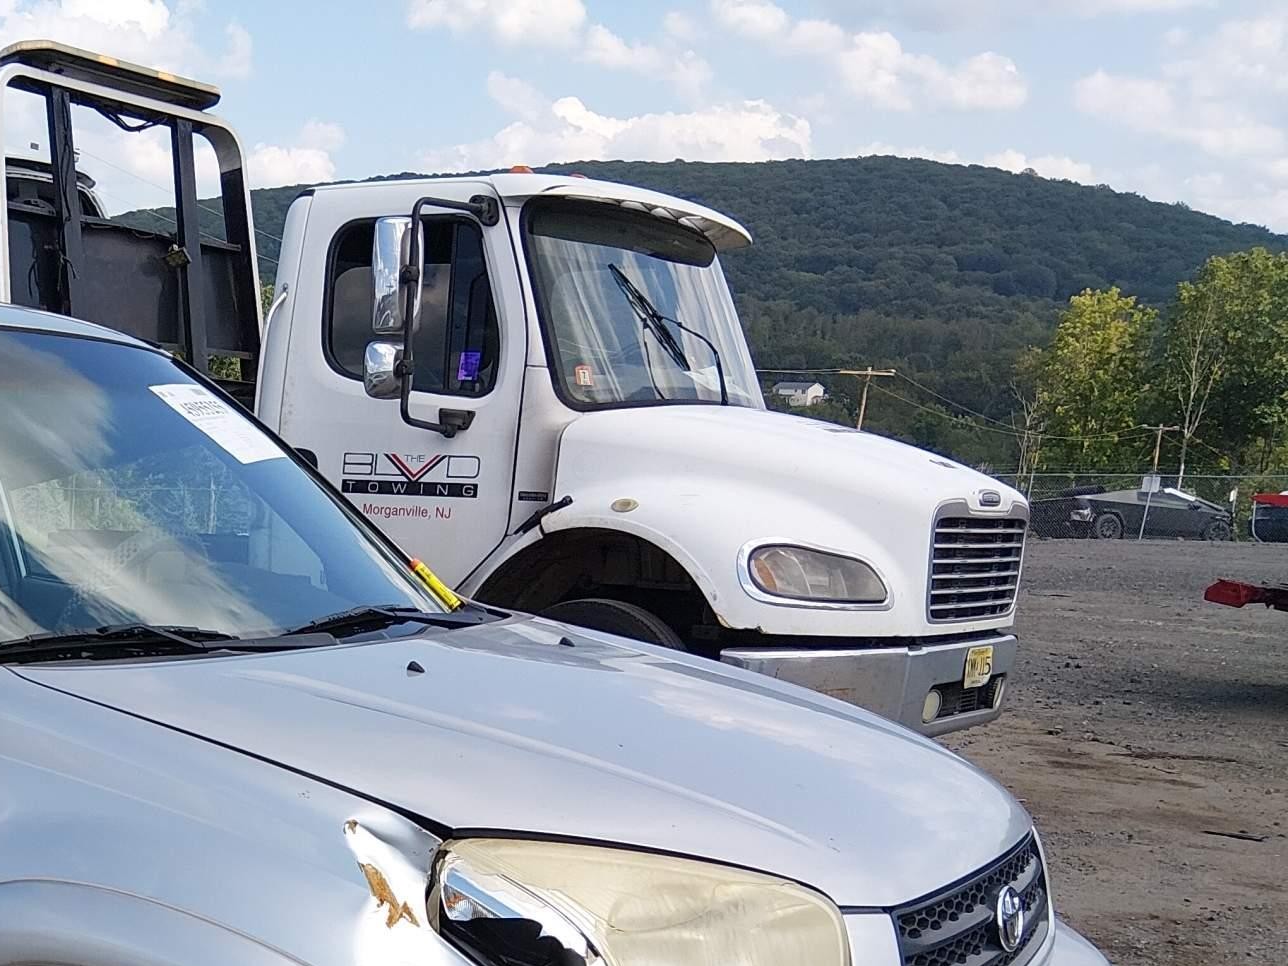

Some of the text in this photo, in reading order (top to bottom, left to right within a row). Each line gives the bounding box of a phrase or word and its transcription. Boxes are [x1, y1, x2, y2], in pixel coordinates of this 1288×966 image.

[404, 454, 425, 463] THE
[342, 452, 481, 482] BLVD
[346, 481, 475, 496] TOWING
[362, 503, 452, 520] Morganville, NJ
